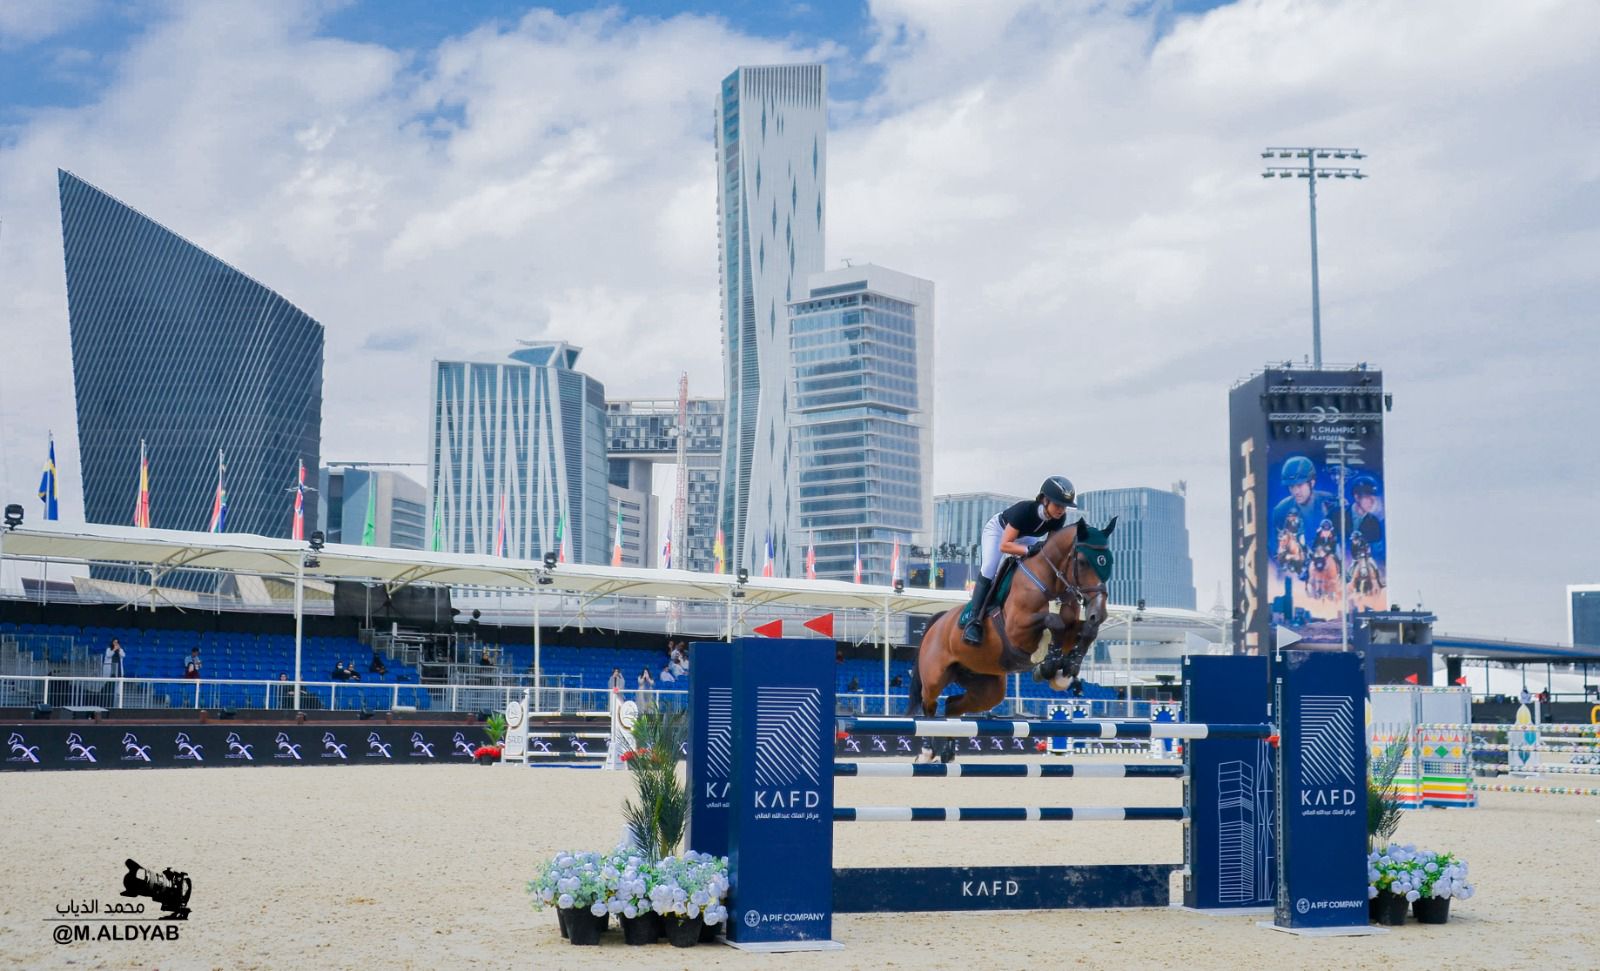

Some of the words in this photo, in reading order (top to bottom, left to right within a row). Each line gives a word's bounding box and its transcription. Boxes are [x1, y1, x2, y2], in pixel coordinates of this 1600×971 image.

[1318, 425, 1367, 434] CHAMPIOS
[754, 790, 820, 808] KAFD
[1301, 789, 1356, 806] KAFD
[805, 812, 819, 820] مركز
[962, 880, 1019, 897] KAFD
[1316, 901, 1329, 909] PIF
[1329, 900, 1364, 909] COMPANY
[761, 914, 768, 922] A
[769, 913, 783, 922] PIF
[783, 912, 825, 922] COMPANY
